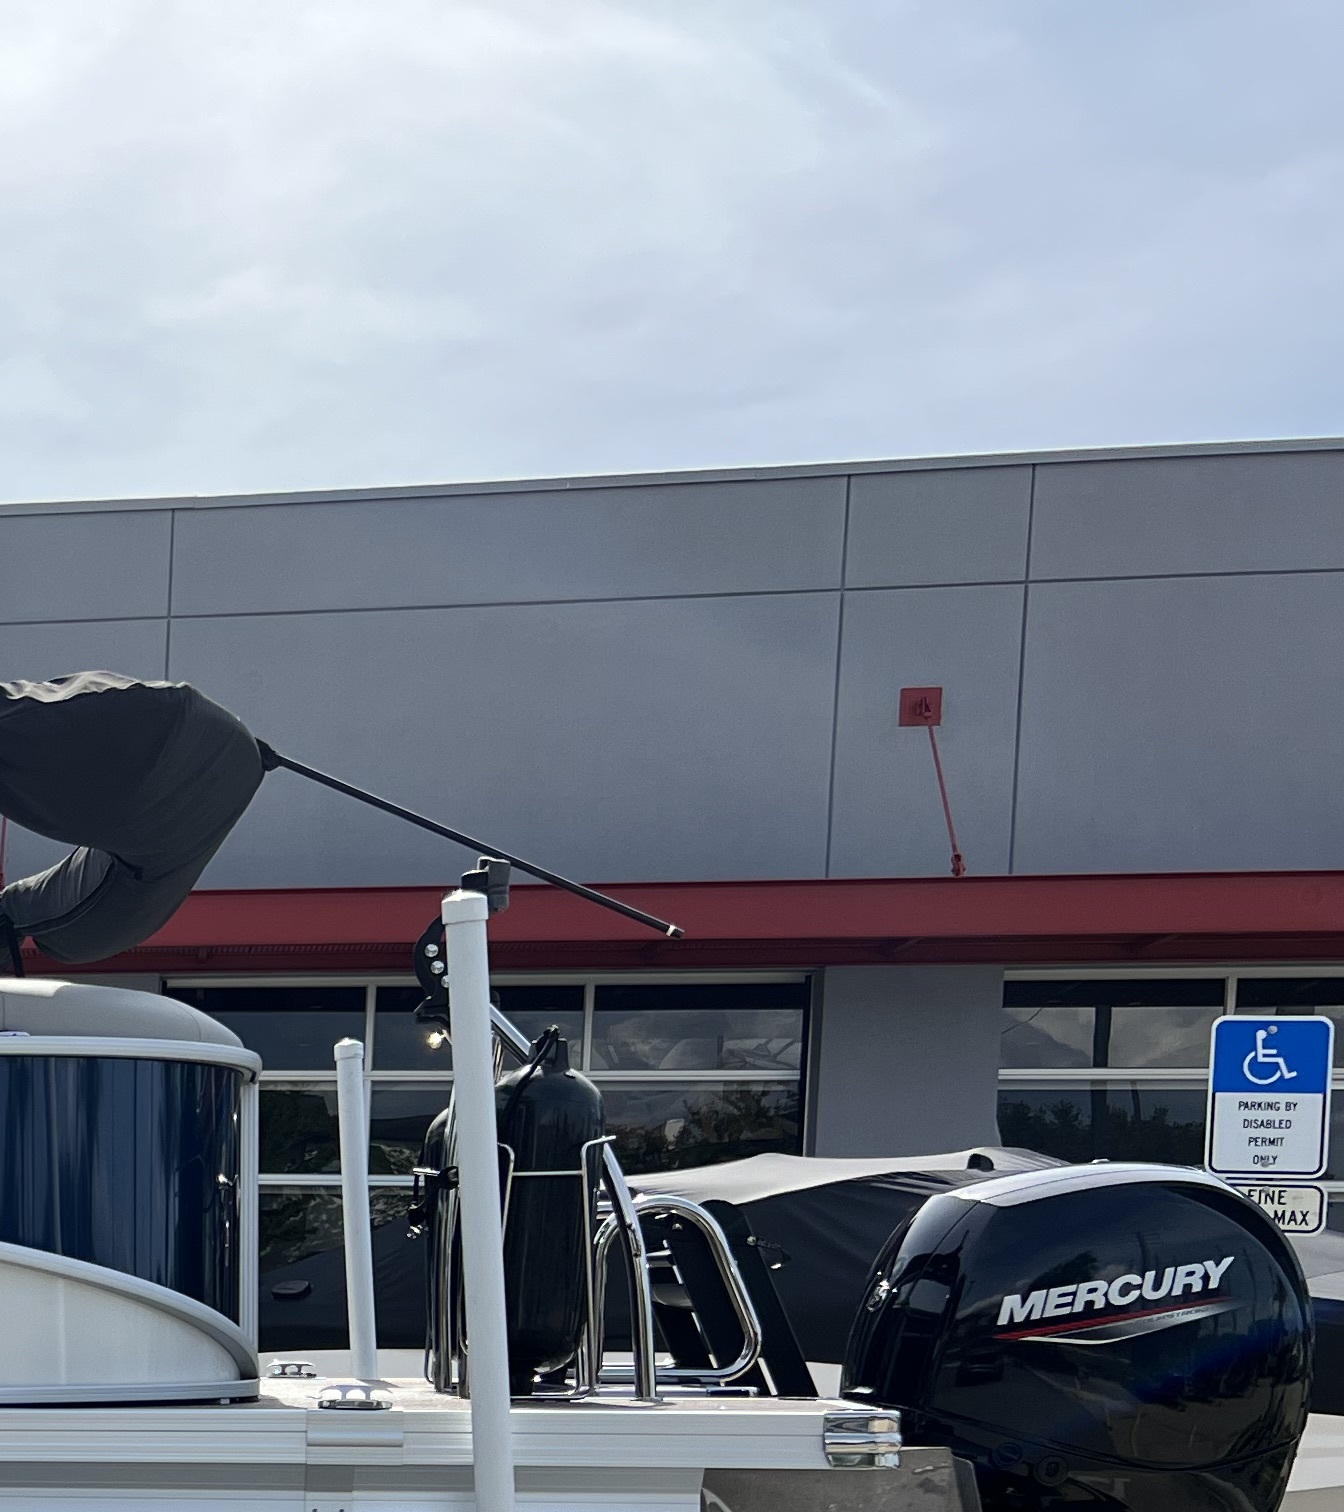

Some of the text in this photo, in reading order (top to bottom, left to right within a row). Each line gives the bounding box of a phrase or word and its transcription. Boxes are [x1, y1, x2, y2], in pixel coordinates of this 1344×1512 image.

[1238, 1101, 1298, 1111] PARKING BY
[1243, 1119, 1292, 1129] DISABLED
[1248, 1137, 1285, 1147] PERMIT
[1272, 1210, 1310, 1227] MAX
[996, 1256, 1236, 1326] MERCURY
